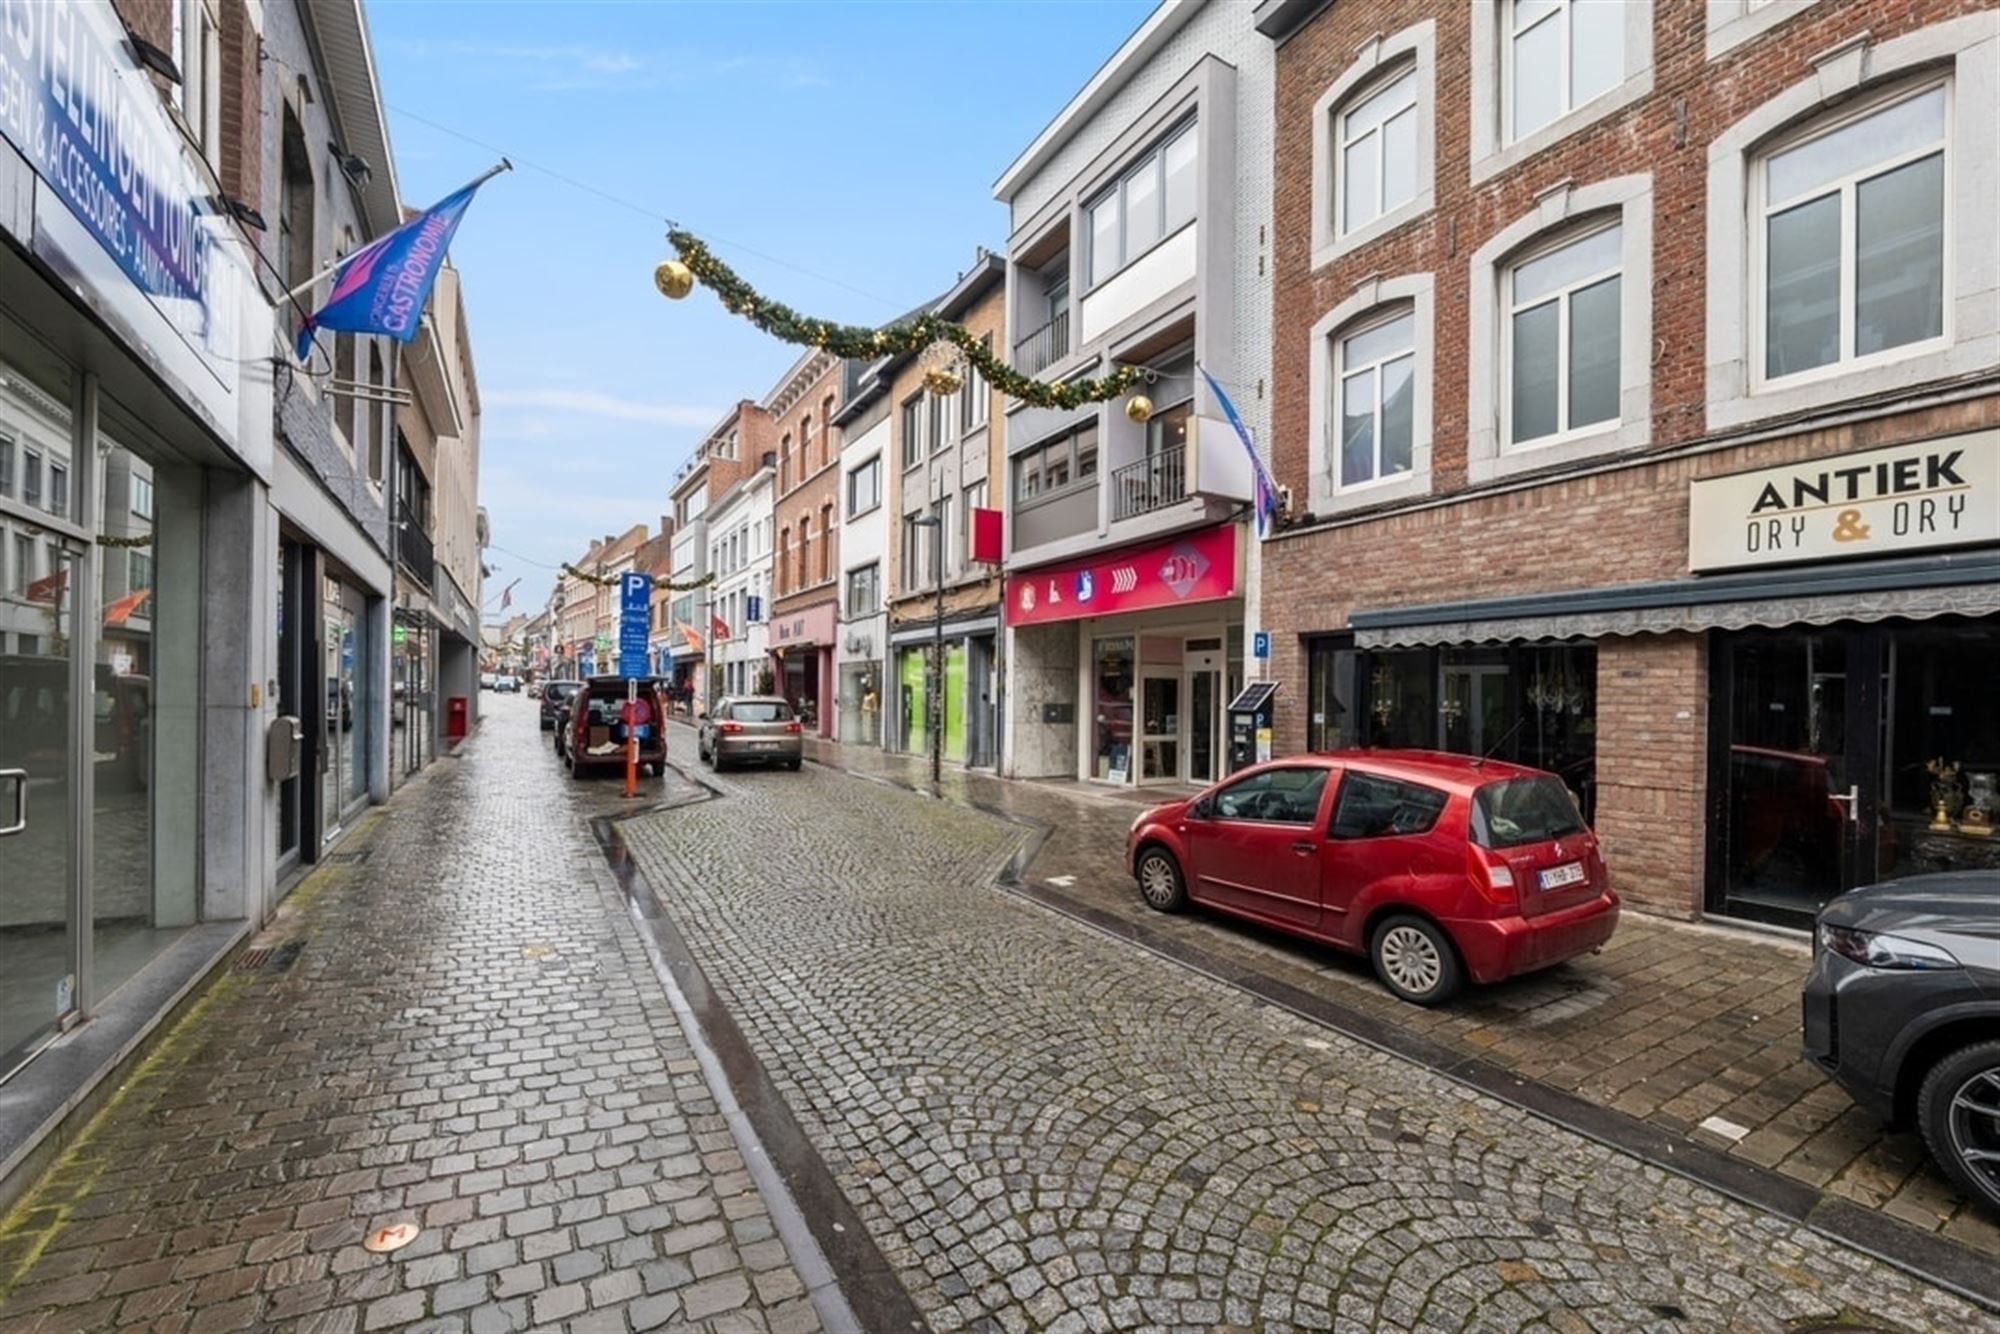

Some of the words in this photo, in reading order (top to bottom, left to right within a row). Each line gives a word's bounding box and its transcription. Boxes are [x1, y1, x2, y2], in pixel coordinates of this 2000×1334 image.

[383, 213, 449, 331] GASTRONOMIE
[1751, 450, 1966, 514] ANTIEK
[1747, 516, 1805, 553] ORY
[1832, 509, 1870, 542] &
[1893, 494, 1965, 536] ORY
[628, 576, 644, 596] P
[1256, 637, 1266, 652] P
